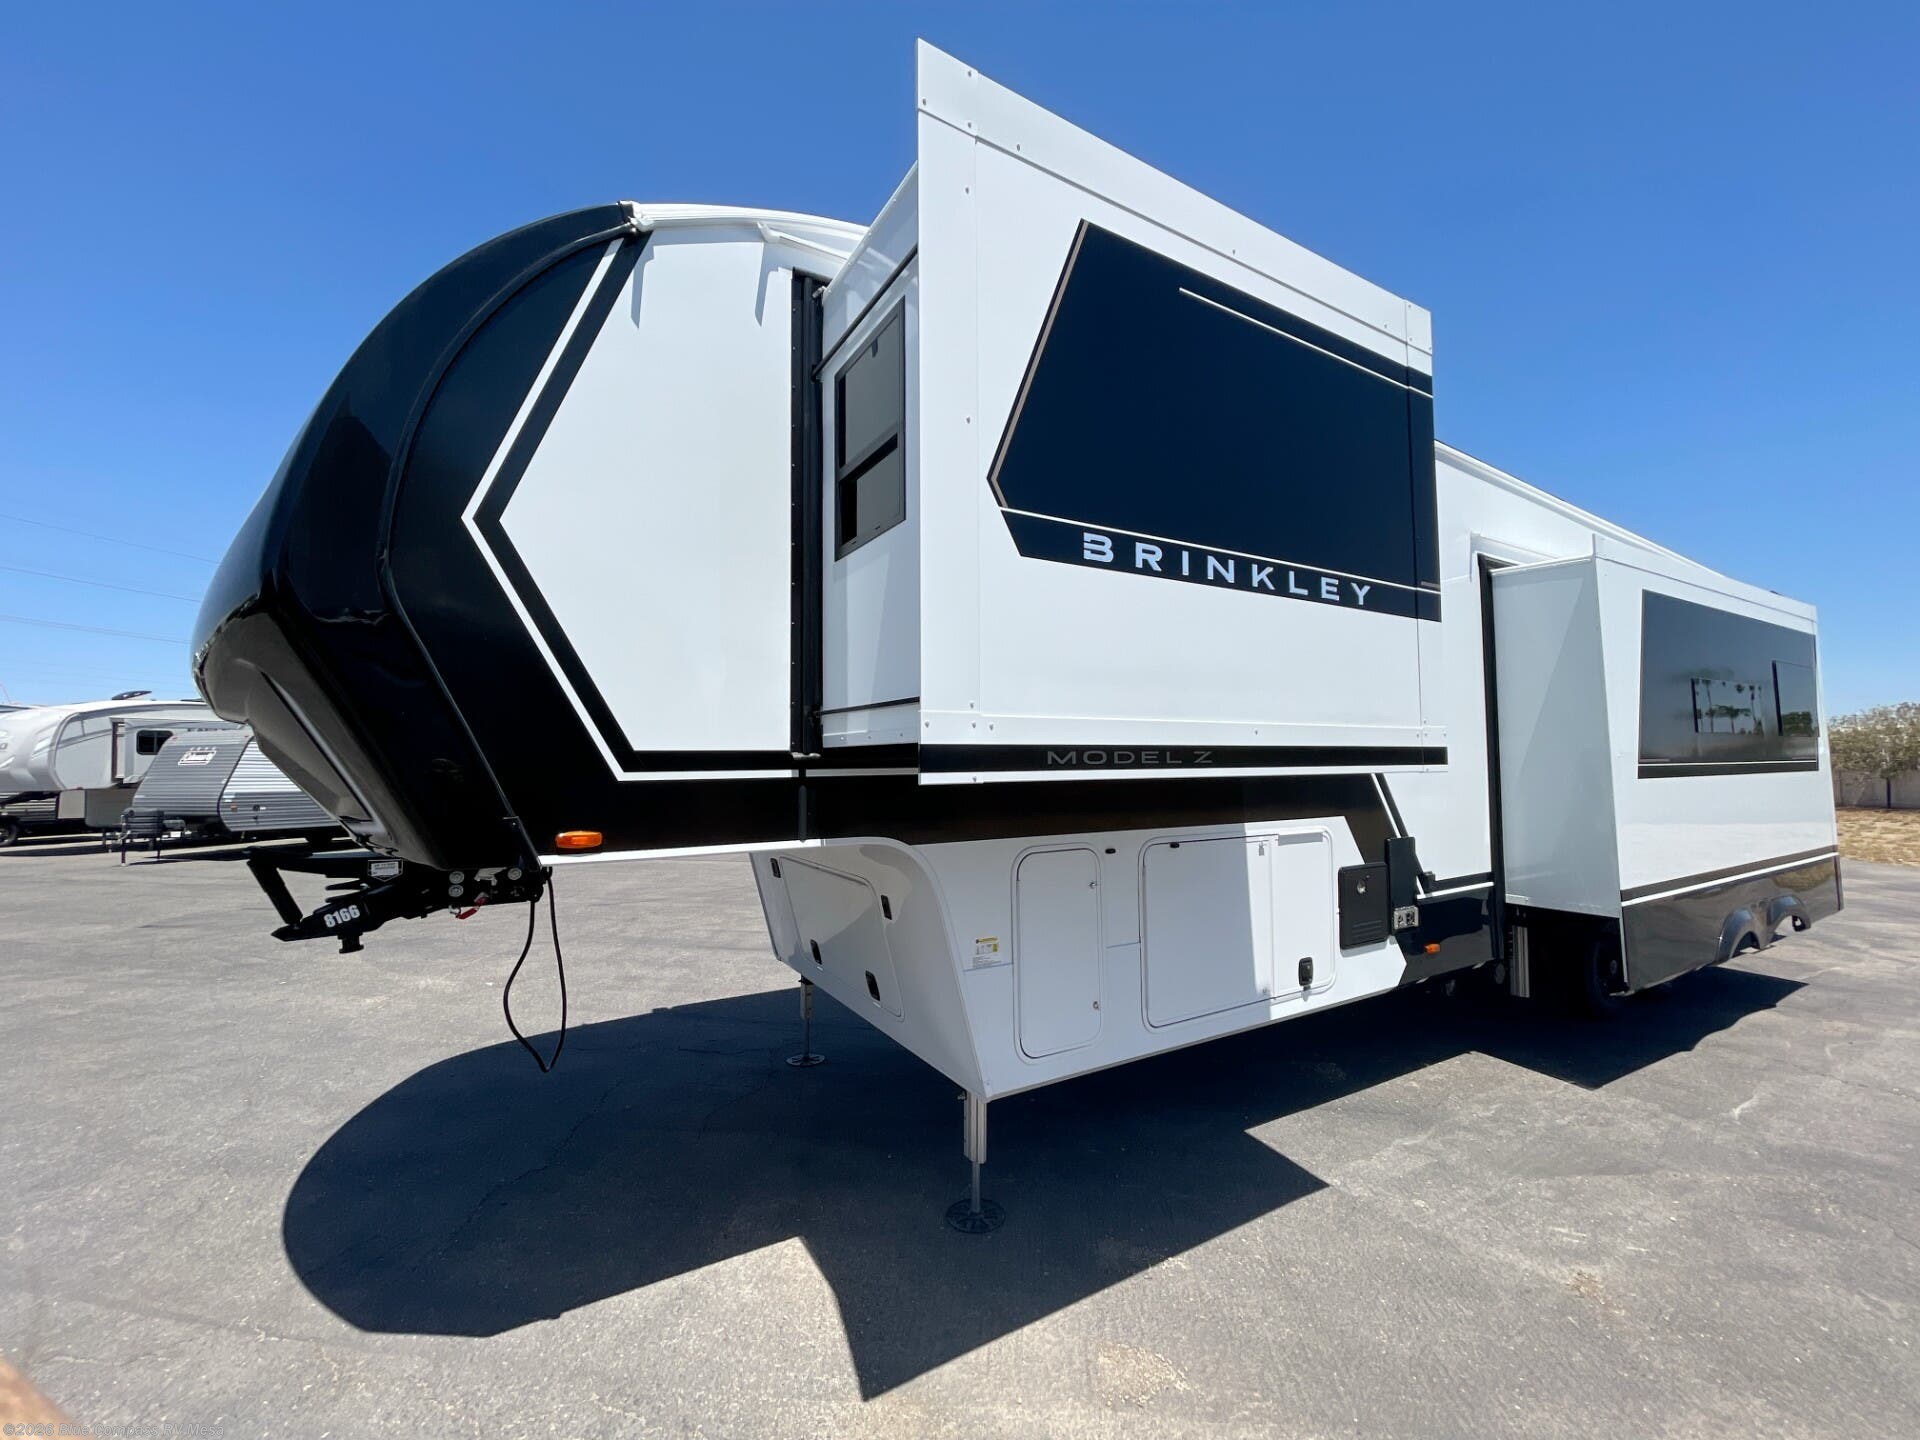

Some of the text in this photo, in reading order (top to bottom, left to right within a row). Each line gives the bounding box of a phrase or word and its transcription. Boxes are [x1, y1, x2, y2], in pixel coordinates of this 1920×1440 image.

[1083, 532, 1372, 606] BRINKLEY
[1047, 750, 1214, 765] MODEL Z
[323, 904, 361, 928] 8166
